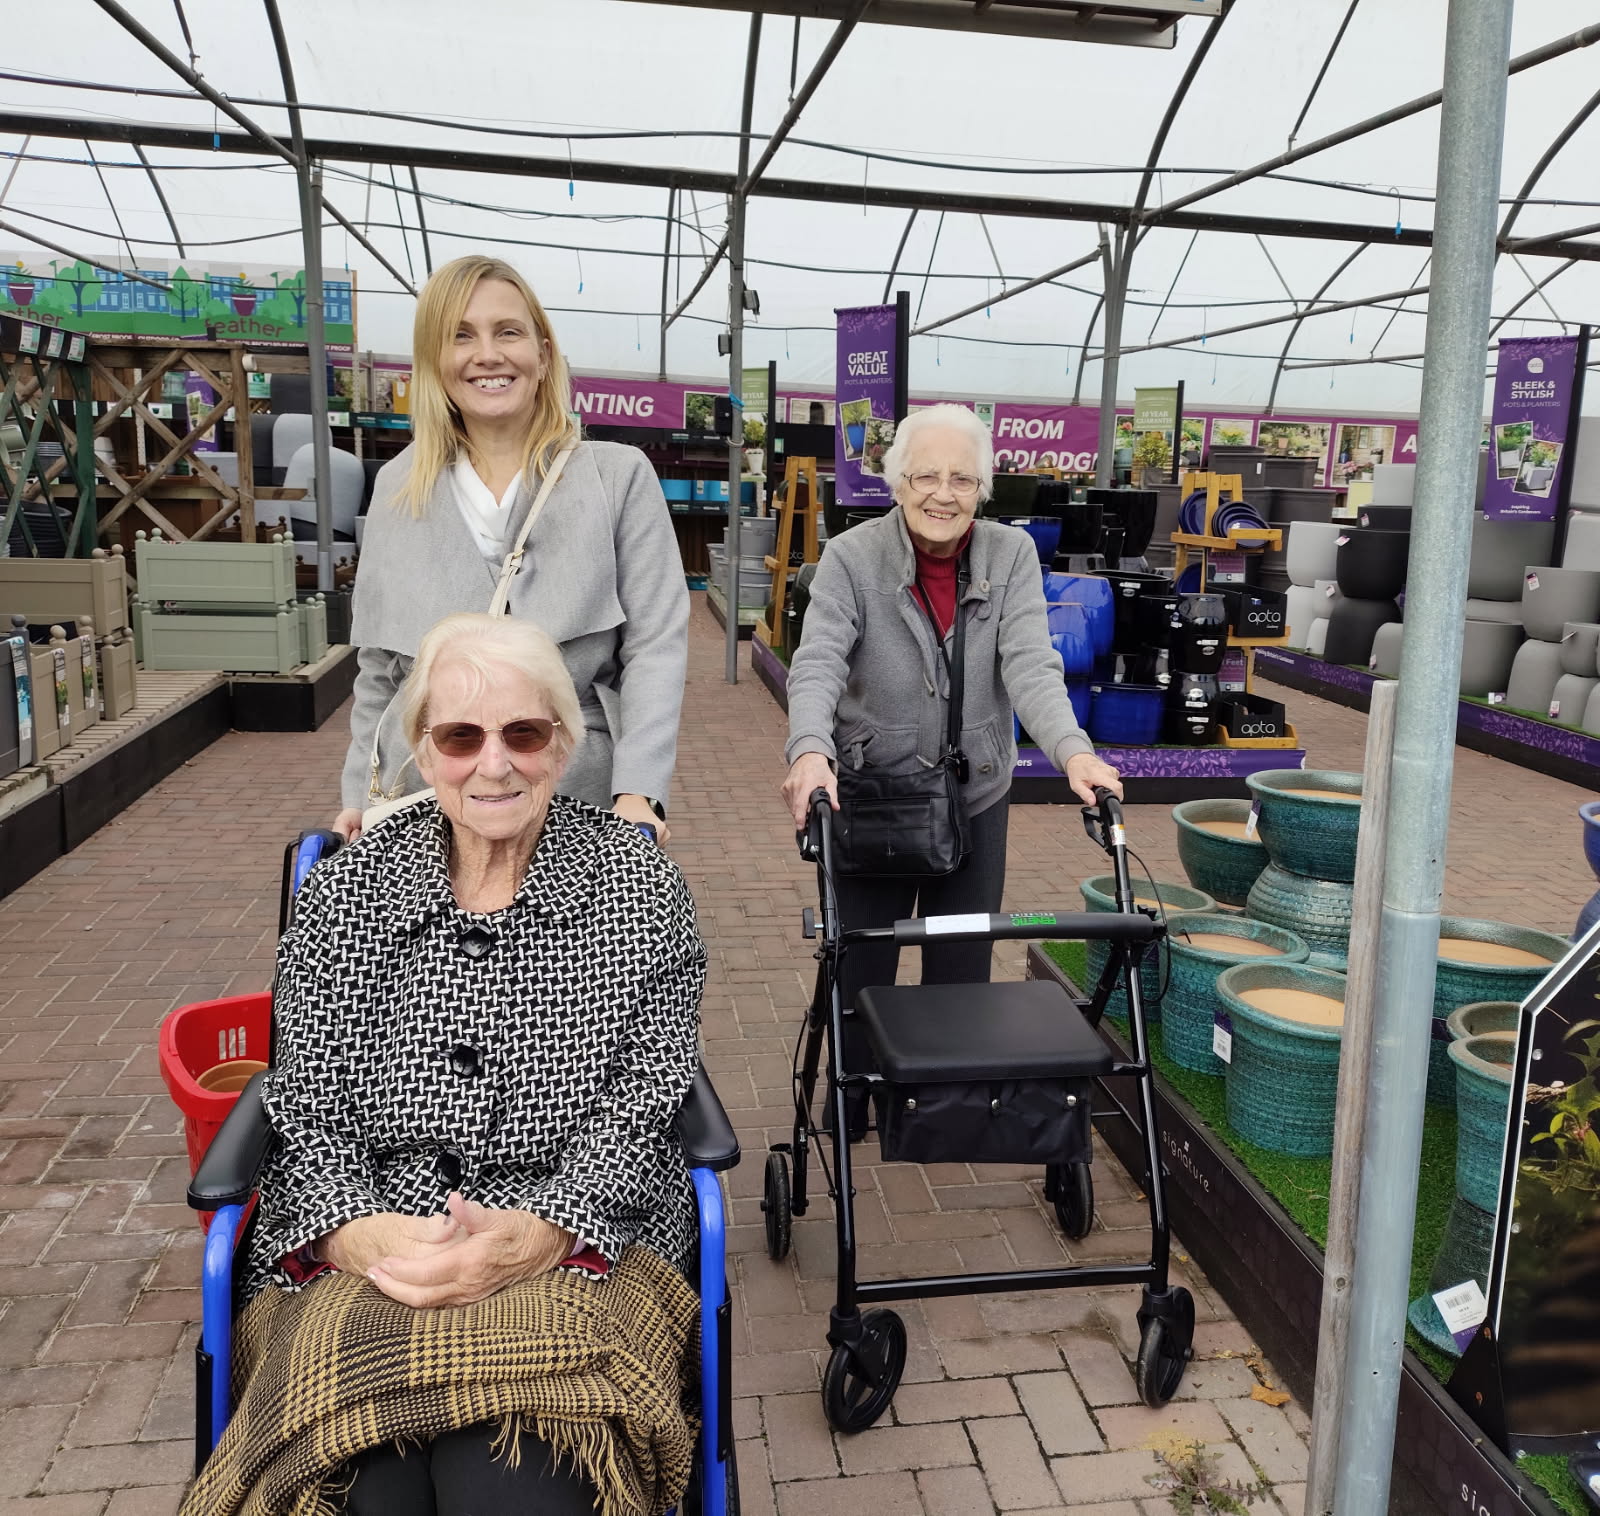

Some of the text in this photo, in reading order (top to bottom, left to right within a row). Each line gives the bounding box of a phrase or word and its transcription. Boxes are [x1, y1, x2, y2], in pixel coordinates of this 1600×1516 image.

[205, 318, 285, 337] feather
[848, 351, 889, 364] GREAT
[847, 363, 889, 376] VALUE
[1511, 380, 1556, 390] SLEEK &
[1510, 390, 1555, 399] STYLISH
[574, 391, 655, 417] NTING
[997, 417, 1065, 440] FROM
[1247, 609, 1281, 625] apta
[1241, 720, 1276, 736] apta
[1162, 1130, 1210, 1193] signature
